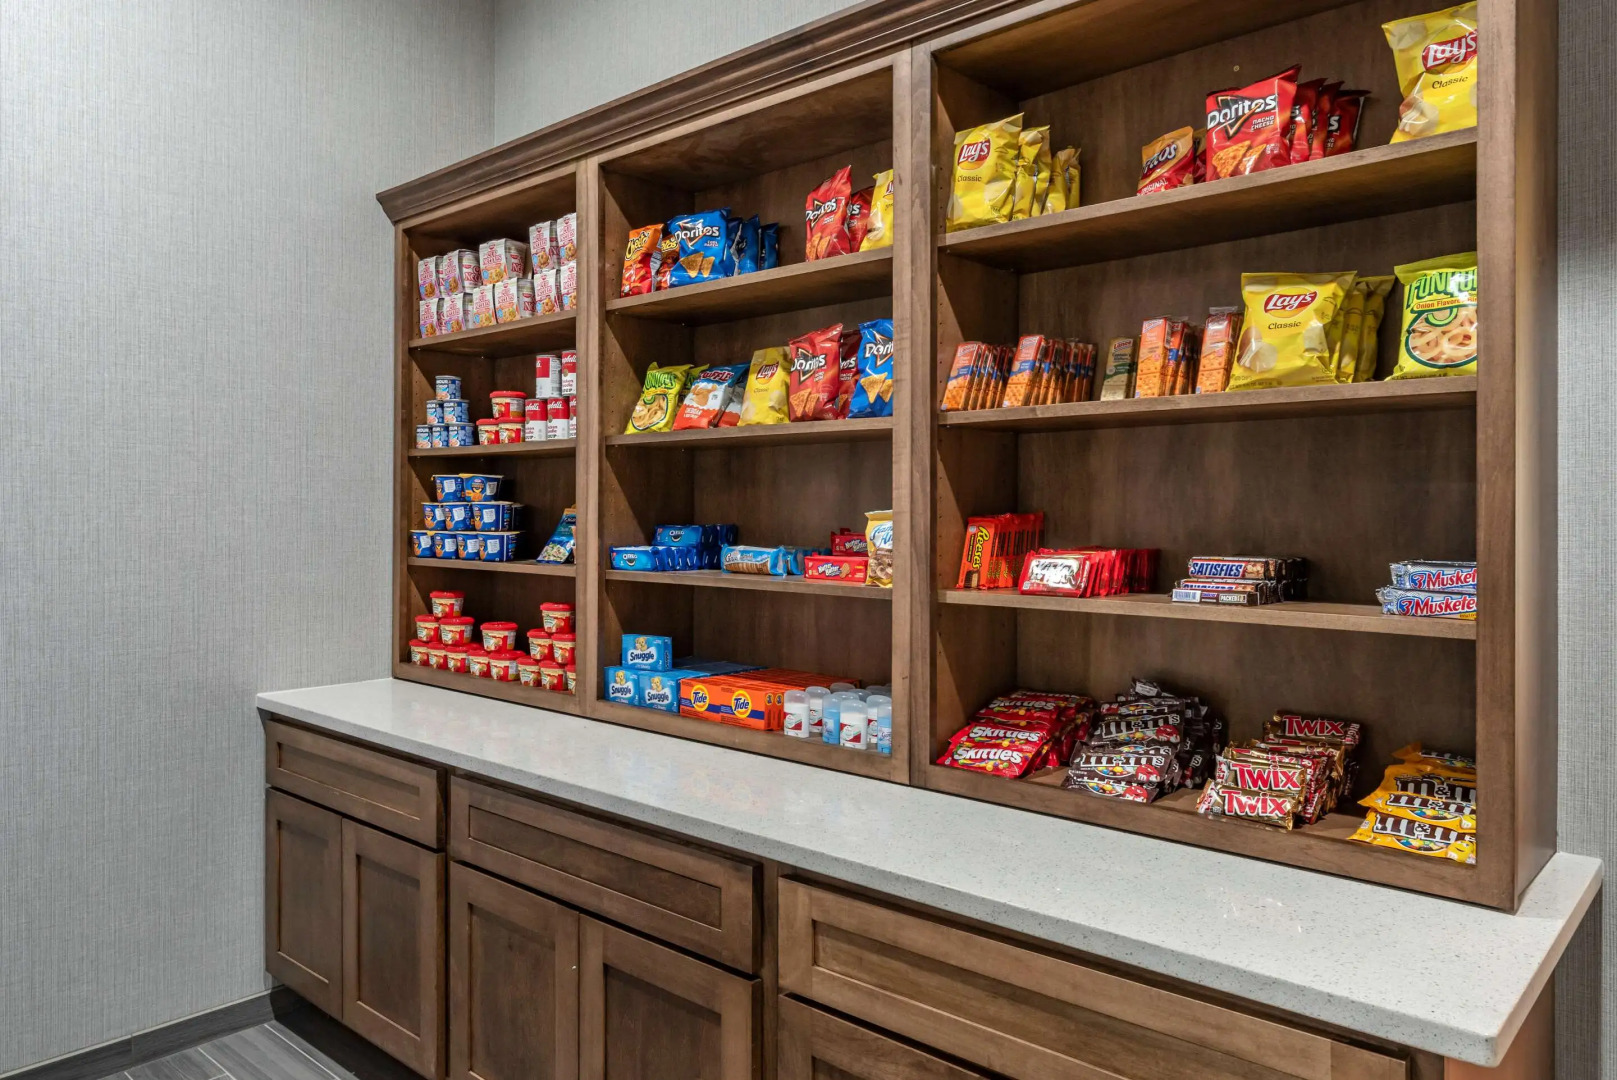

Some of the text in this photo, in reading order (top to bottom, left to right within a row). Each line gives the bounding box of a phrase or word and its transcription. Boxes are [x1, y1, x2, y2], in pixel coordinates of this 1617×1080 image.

[1427, 33, 1477, 68] Lay's
[1431, 75, 1468, 89] Classic
[1207, 94, 1277, 130] Doritos
[1252, 115, 1275, 124] NACHO
[1251, 120, 1275, 132] CHEESE
[959, 140, 990, 162] Lay's
[957, 174, 983, 183] Classic
[674, 226, 720, 244] Doritos
[1265, 292, 1315, 312] Lay's
[1416, 301, 1435, 310] Onion
[1436, 298, 1464, 307] Flavore
[1268, 319, 1301, 331] Classic
[755, 360, 777, 379] Lay's
[790, 353, 826, 372] Doritos
[973, 525, 990, 570] Reese's
[1191, 562, 1243, 578] SATISFIES
[1411, 574, 1424, 589] 3
[1398, 600, 1415, 616] 3
[629, 651, 655, 662] Snuggle
[611, 685, 632, 697] Snuggle
[646, 691, 669, 703] Snuggle
[692, 691, 708, 705] Tide
[733, 697, 750, 712] Tide
[988, 699, 1056, 710] Skittles
[969, 725, 1041, 743] Skittles
[953, 746, 1023, 764] Skittles
